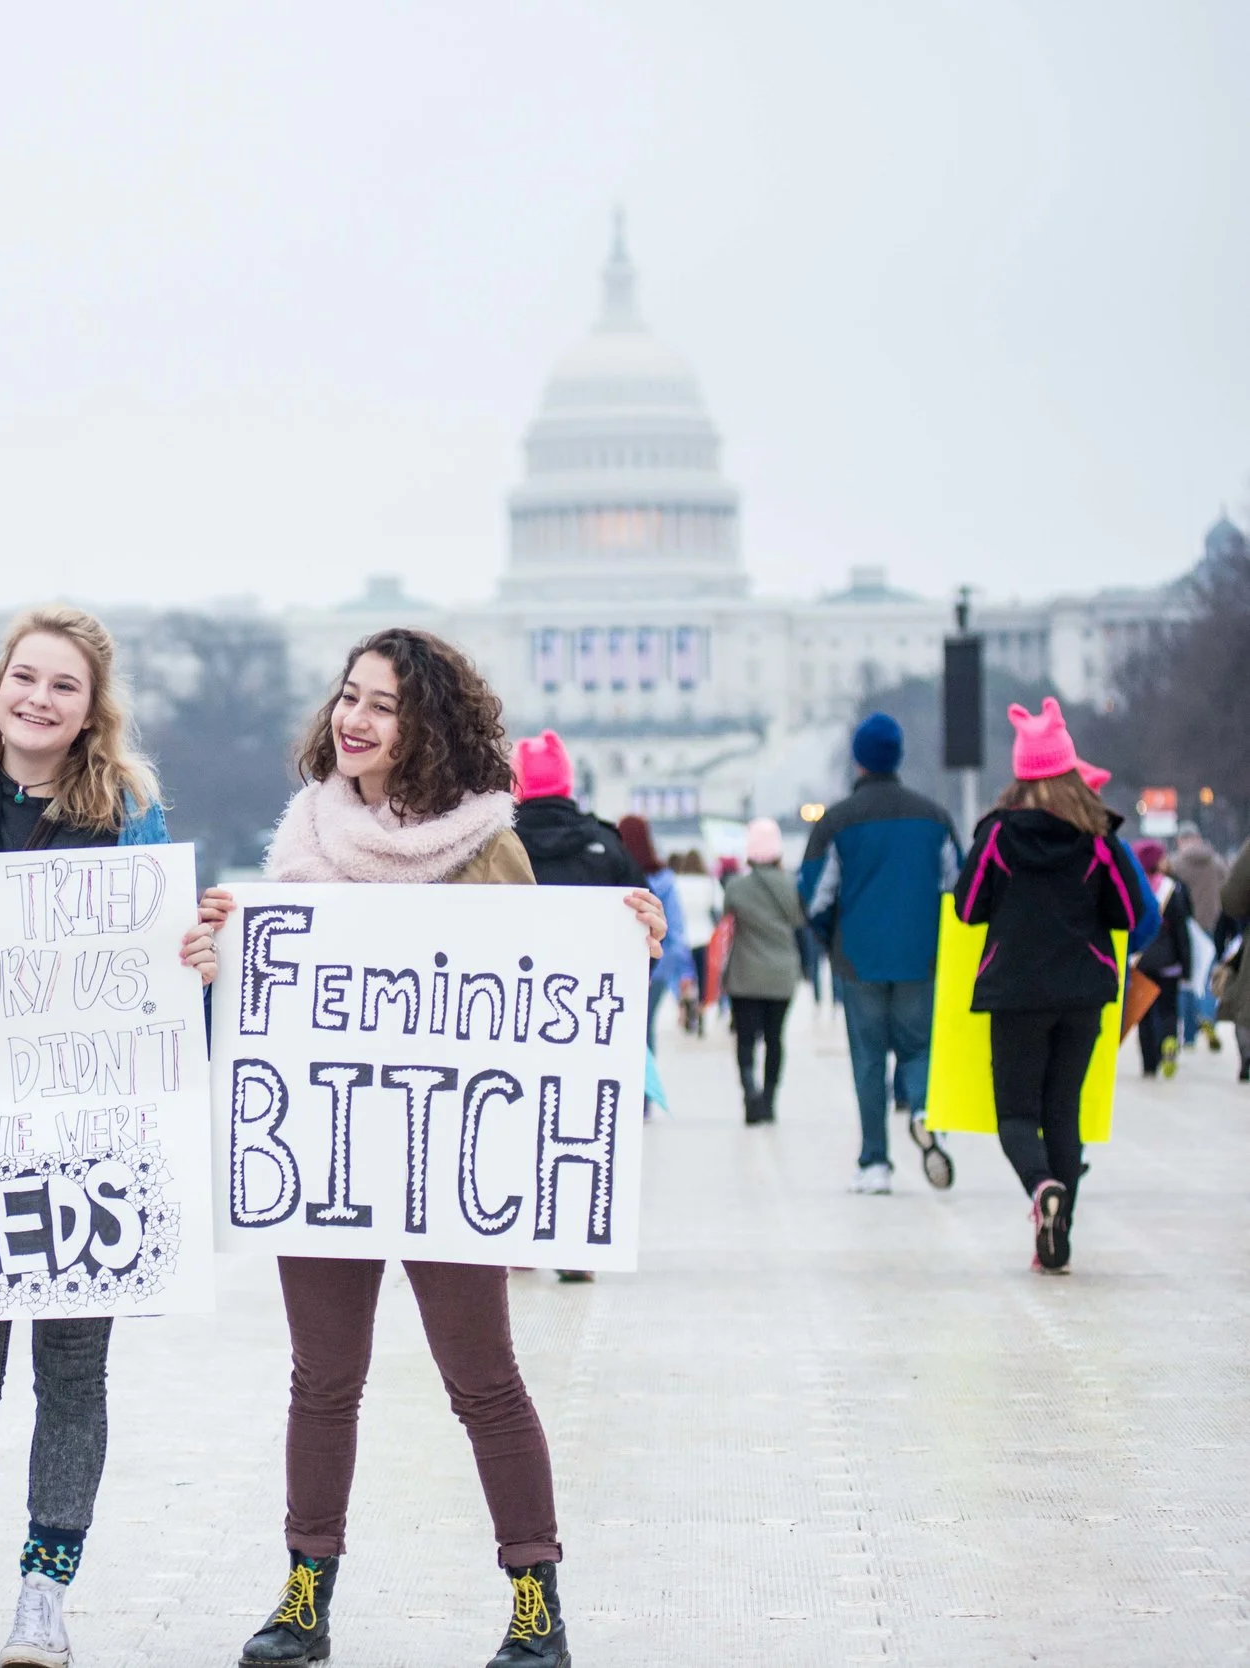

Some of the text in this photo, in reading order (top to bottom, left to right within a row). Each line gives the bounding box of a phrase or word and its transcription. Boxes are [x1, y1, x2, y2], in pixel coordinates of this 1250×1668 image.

[5, 853, 165, 942] TRIED
[8, 1019, 185, 1103] DIDN'T
[54, 1103, 160, 1159] WERE
[230, 1058, 620, 1245] BITCH
